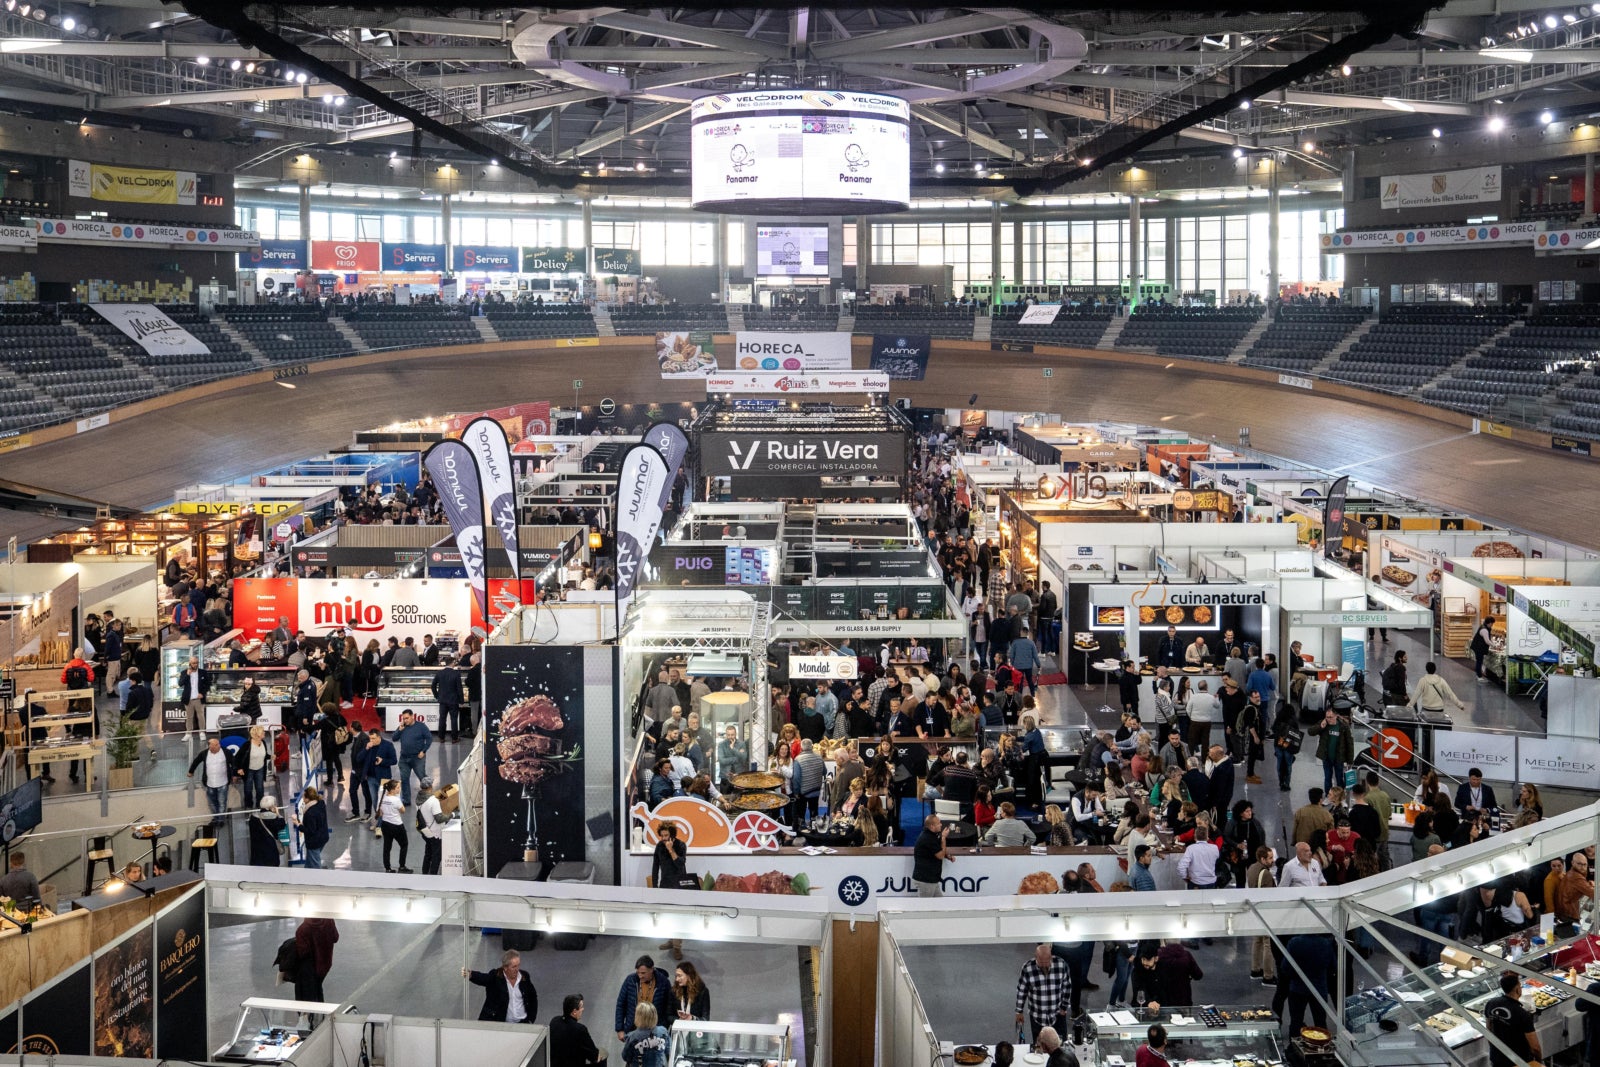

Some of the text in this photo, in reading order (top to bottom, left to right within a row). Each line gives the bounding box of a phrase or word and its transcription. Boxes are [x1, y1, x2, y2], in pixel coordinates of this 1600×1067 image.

[726, 174, 758, 184] Panamar
[839, 173, 872, 184] Panamar
[263, 250, 296, 260] Servera
[405, 253, 436, 262] Servera
[476, 255, 509, 264] Servera
[534, 259, 567, 271] Delicy
[603, 260, 628, 272] Delicy
[767, 440, 879, 460] Ruiz Vera
[767, 463, 878, 471] COMERCIAL INSTALADORA
[1198, 499, 1217, 508] 2024
[1170, 590, 1268, 605] cuinanatural
[314, 595, 383, 626] milo
[391, 604, 419, 614] FOOD
[391, 614, 447, 625] SOLUTIONS
[1342, 614, 1388, 624] RC SERVEIS
[882, 625, 902, 633] SUPPLY
[1384, 736, 1400, 760] 2
[1440, 750, 1509, 763] MEDIPEIX
[1525, 758, 1596, 771] MEDIPEIX
[160, 934, 200, 973] BARQUERO
[124, 958, 148, 979] blanco
[121, 969, 148, 993] del mar
[138, 981, 148, 992] su
[107, 991, 148, 1026] restaurante
[29, 1041, 42, 1050] THE
